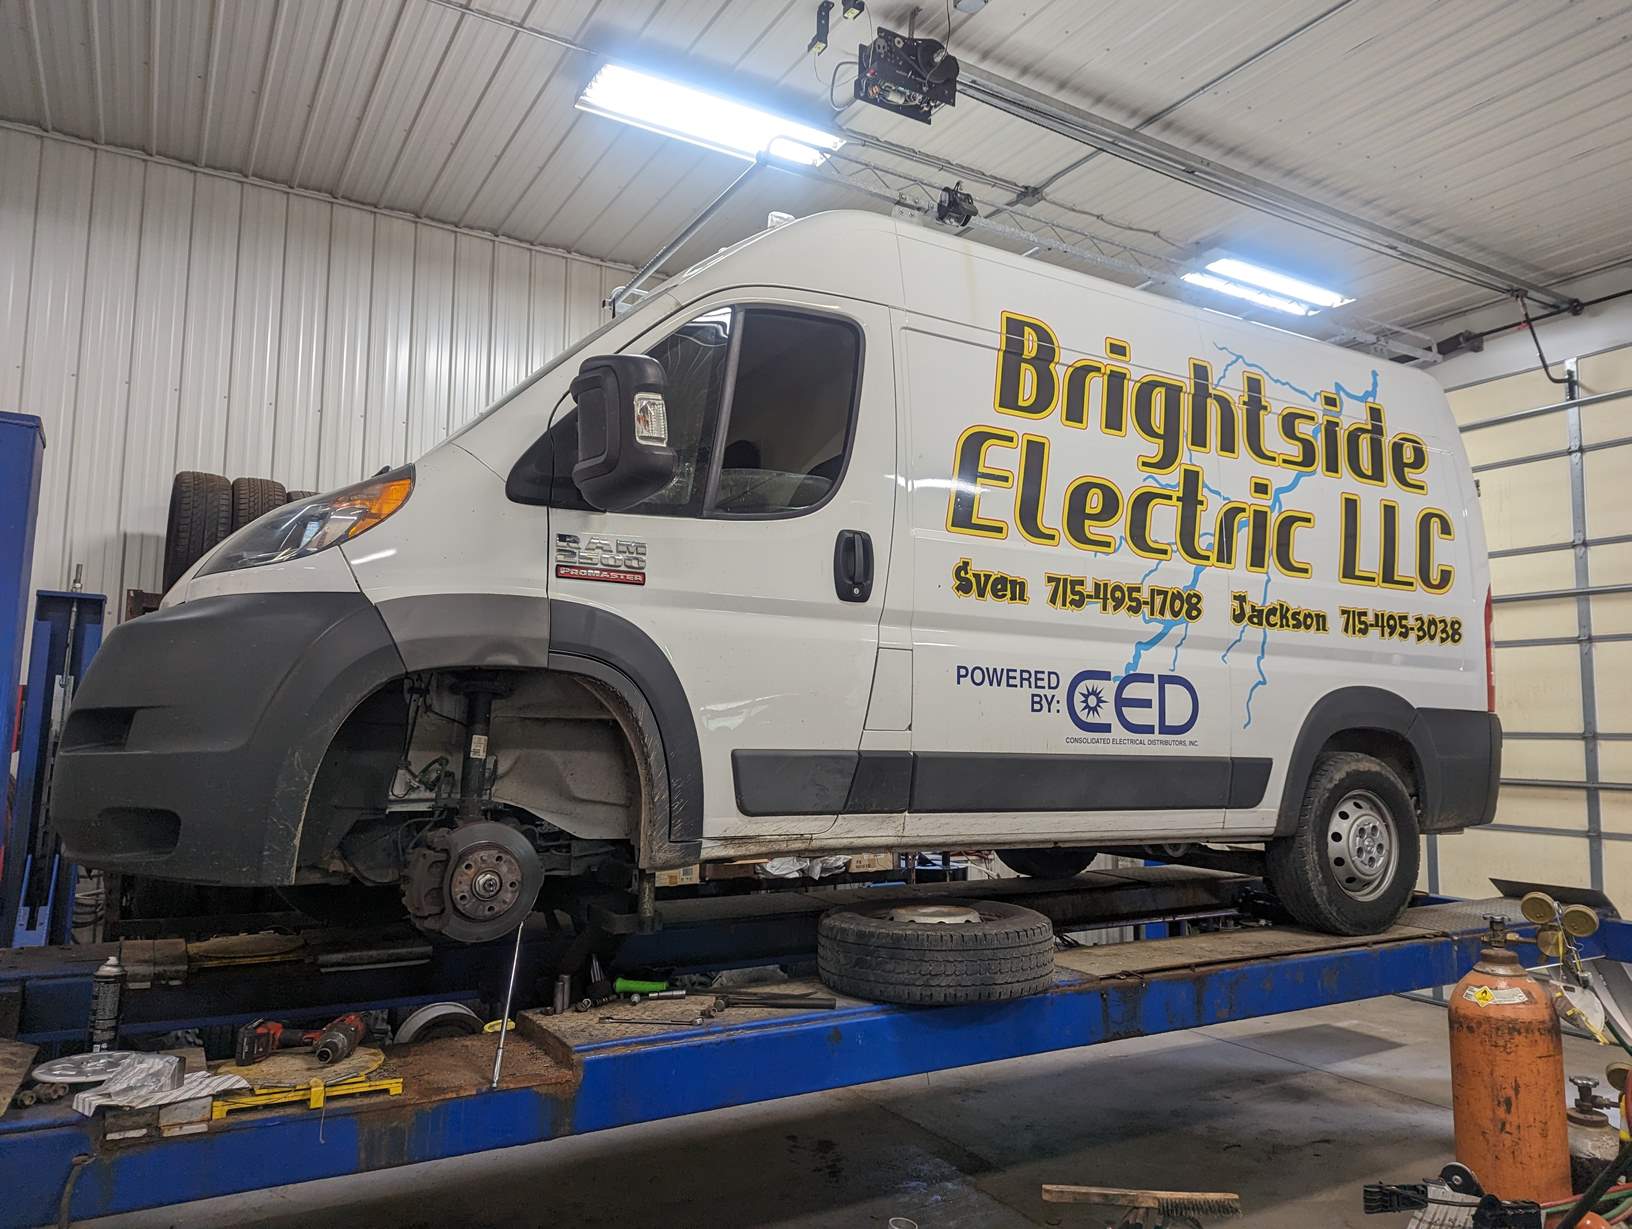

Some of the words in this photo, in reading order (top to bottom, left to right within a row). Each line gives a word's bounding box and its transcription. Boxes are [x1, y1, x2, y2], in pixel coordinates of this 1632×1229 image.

[993, 309, 1430, 495] Brightside
[945, 424, 1316, 580] Electric
[1338, 492, 1455, 595] LLC
[555, 533, 647, 556] RAM
[559, 566, 643, 582] PROMASTER
[951, 557, 1030, 606] Sven
[1044, 573, 1204, 624] 715-495-1708
[1229, 590, 1329, 635] Jackson
[1339, 606, 1464, 646] 715-495-3038
[956, 665, 1061, 691] POWERED
[1030, 692, 1061, 715] BY:
[1066, 669, 1200, 736] CED
[1065, 736, 1111, 745] CONSOLIDATED
[1112, 737, 1146, 746] ELECTRICAL
